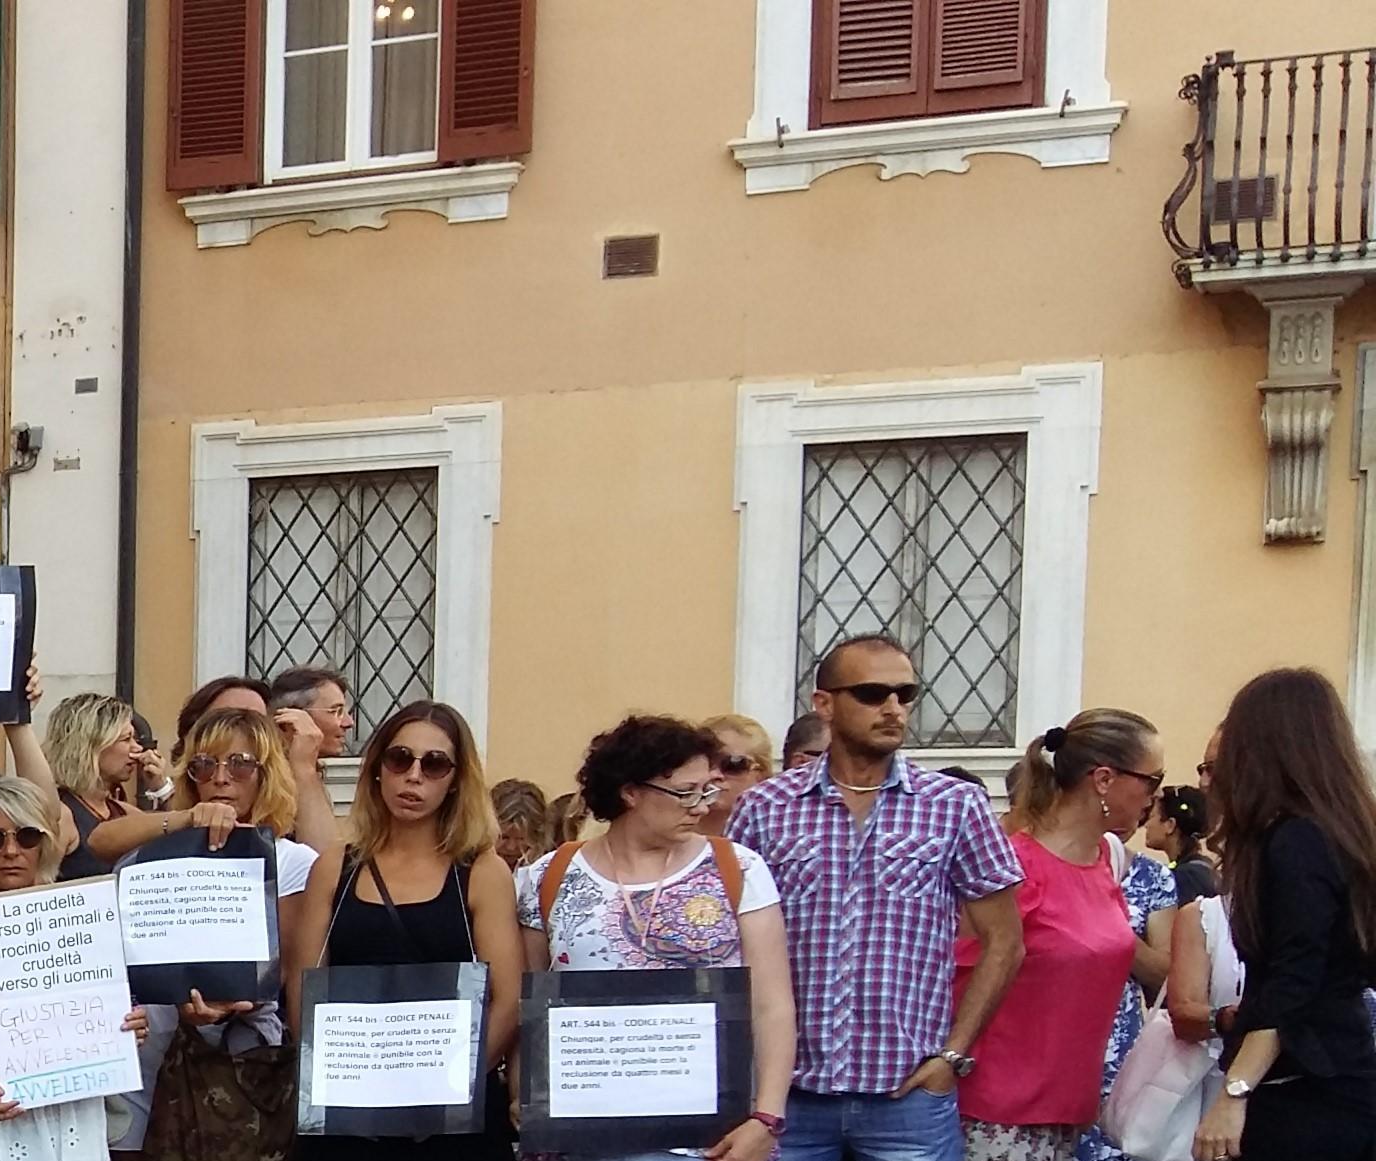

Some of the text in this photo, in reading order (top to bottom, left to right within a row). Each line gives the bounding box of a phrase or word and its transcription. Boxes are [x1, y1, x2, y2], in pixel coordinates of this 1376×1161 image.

[150, 872, 165, 881] 544
[167, 871, 180, 880] bis
[174, 885, 188, 895] per
[2, 893, 86, 919] La crudeltà
[143, 905, 243, 917] animale punibile con la
[25, 915, 43, 937] gli
[48, 908, 101, 930] animali
[105, 908, 115, 923] è
[189, 917, 218, 927] quattro
[220, 917, 238, 925] mesi
[57, 930, 93, 949] della
[21, 949, 83, 973] crudeltà
[43, 969, 60, 990] gli
[64, 964, 114, 984] uomini
[0, 995, 105, 1029] GIUSTIZIA
[347, 1014, 363, 1024] 544
[365, 1014, 377, 1024] bis
[384, 1013, 416, 1024] CODICE
[560, 1019, 581, 1029] ART.
[583, 1019, 601, 1028] 544
[602, 1018, 616, 1028] bis
[624, 1018, 658, 1028] CODICE
[9, 1027, 49, 1048] PER
[74, 1018, 114, 1036] CANI
[370, 1030, 385, 1039] per
[431, 1027, 457, 1035] senza
[609, 1035, 624, 1044] per
[675, 1032, 701, 1041] senza
[370, 1039, 404, 1050] cagiona
[405, 1038, 413, 1046] la
[415, 1038, 440, 1046] morte
[442, 1037, 451, 1045] di
[648, 1044, 656, 1053] la
[658, 1044, 685, 1053] morte
[337, 1051, 371, 1060] animale
[380, 1049, 414, 1060] punibile
[416, 1050, 433, 1058] con
[434, 1049, 443, 1057] la
[371, 1061, 382, 1070] da
[384, 1061, 414, 1071] quattro
[416, 1060, 437, 1068] mesi
[560, 1059, 573, 1067] un
[575, 1057, 611, 1067] animale
[660, 1057, 677, 1065] con
[679, 1056, 688, 1064] la
[611, 1069, 623, 1078] da
[660, 1068, 683, 1076] mesi
[560, 1081, 579, 1091] due
